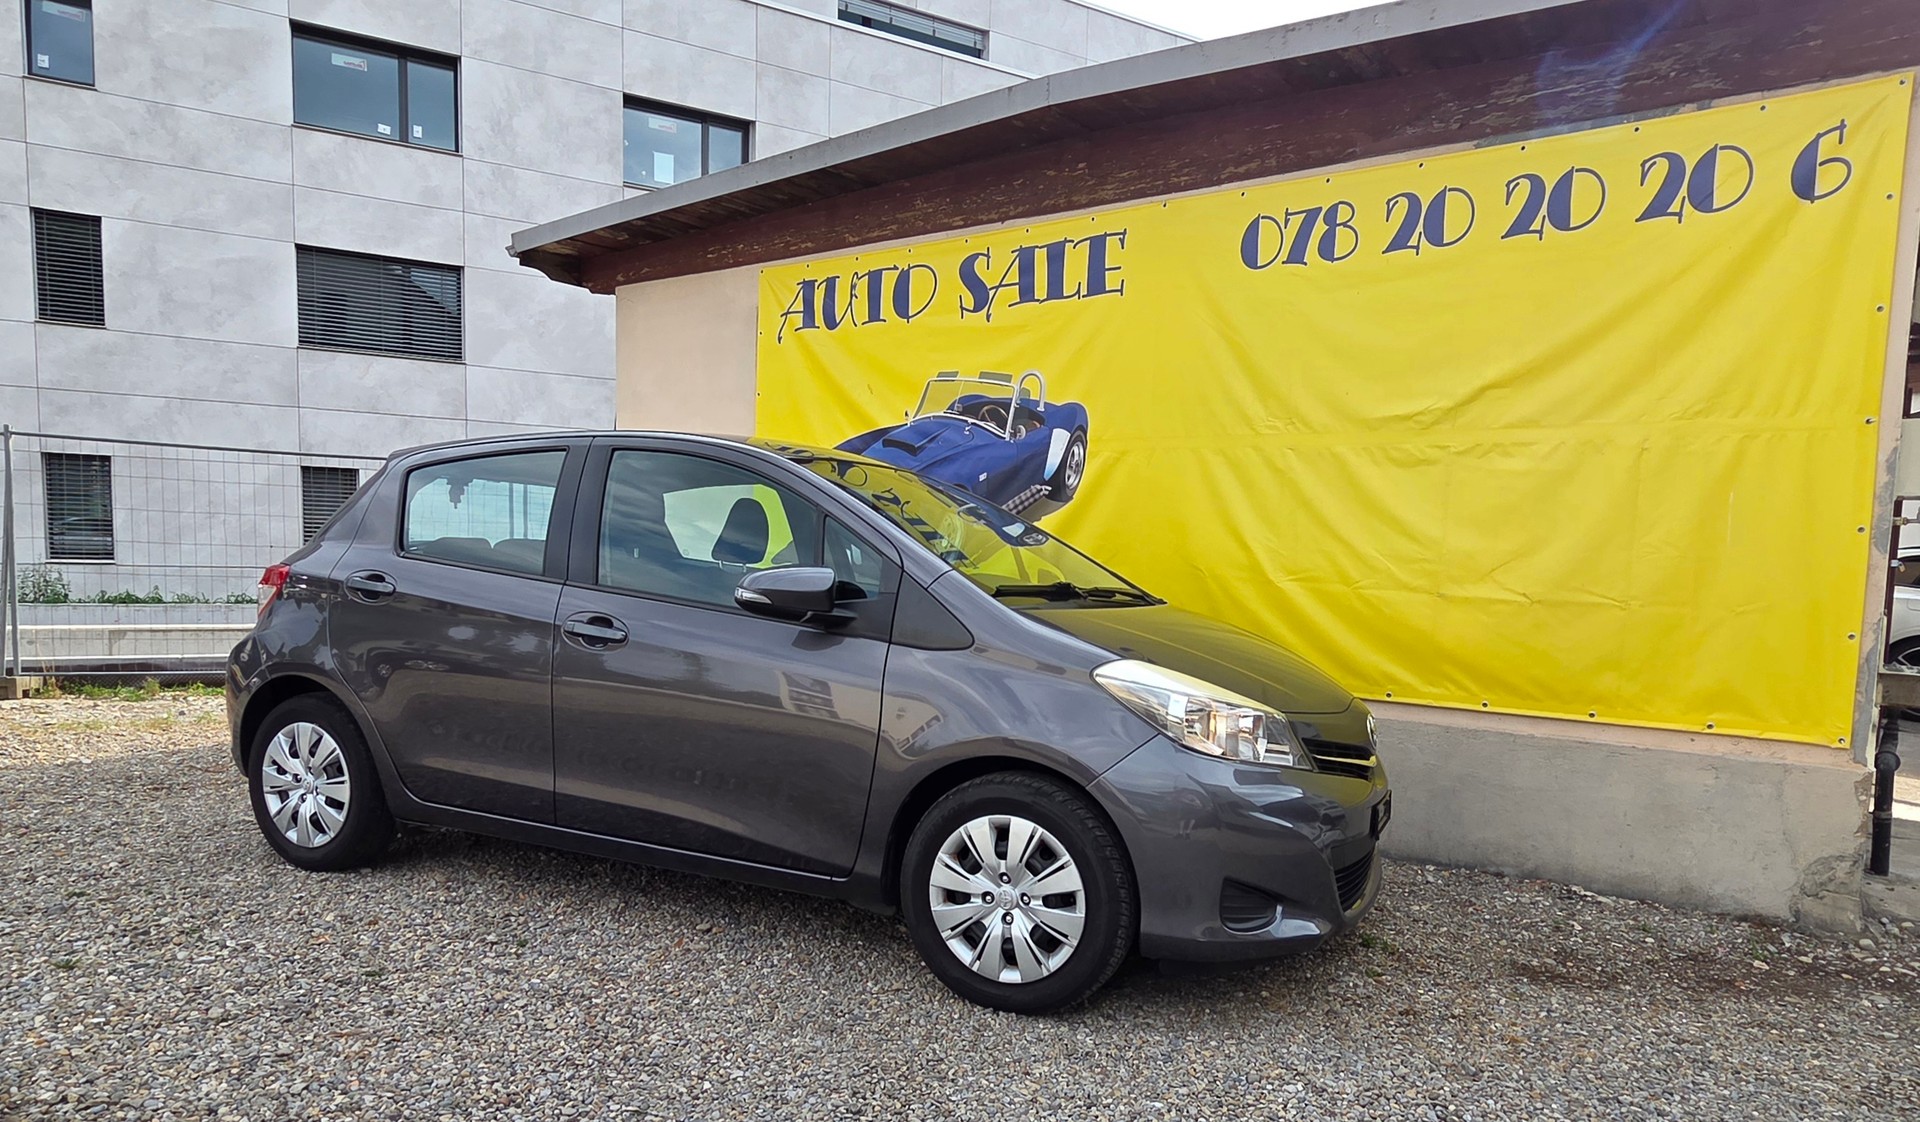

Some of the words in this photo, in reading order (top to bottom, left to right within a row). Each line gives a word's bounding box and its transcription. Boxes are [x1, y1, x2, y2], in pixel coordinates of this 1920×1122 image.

[1240, 200, 1360, 270] 078
[1381, 185, 1475, 256] 20
[1501, 166, 1607, 241] 20
[1635, 143, 1754, 224] 20
[1790, 118, 1852, 204] 6
[777, 263, 938, 345] AUTO
[958, 228, 1127, 323] SALE
